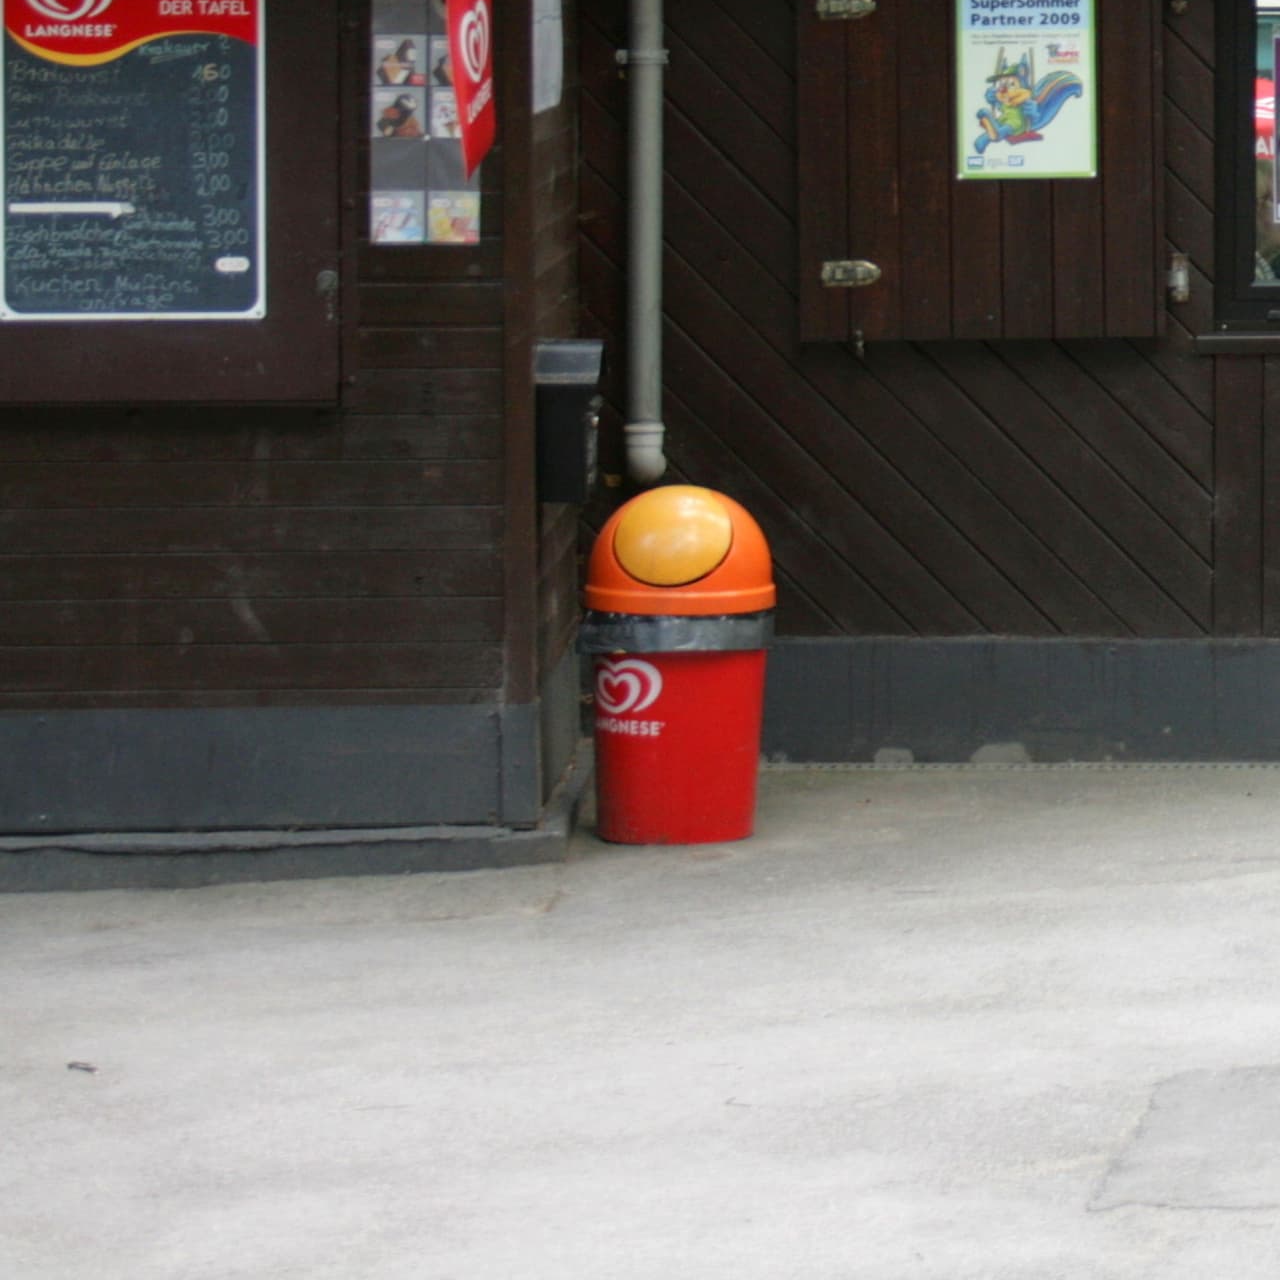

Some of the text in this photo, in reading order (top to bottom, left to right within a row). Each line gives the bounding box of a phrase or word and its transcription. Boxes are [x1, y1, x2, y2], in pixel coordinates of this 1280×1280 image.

[159, 0, 250, 16] DER TAFEL
[970, 13, 1081, 26] Partner 2009
[25, 24, 114, 38] LANGNESE
